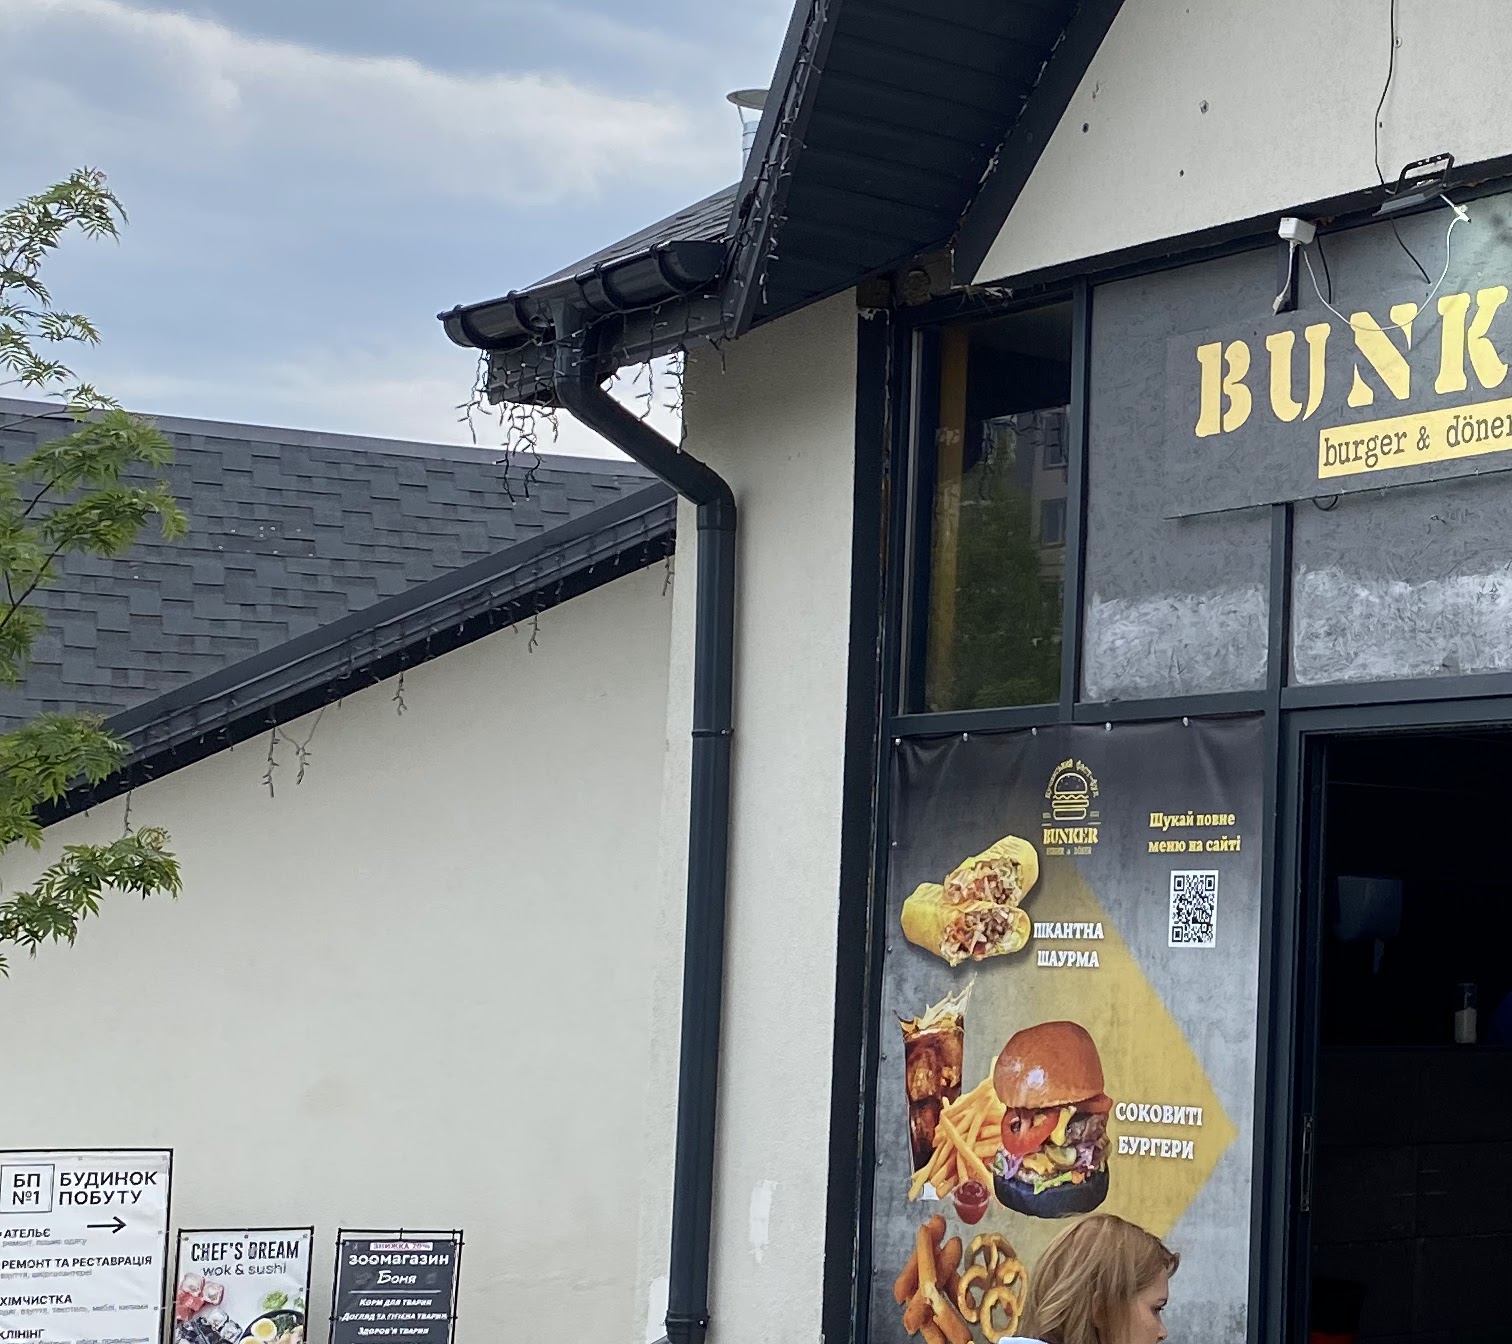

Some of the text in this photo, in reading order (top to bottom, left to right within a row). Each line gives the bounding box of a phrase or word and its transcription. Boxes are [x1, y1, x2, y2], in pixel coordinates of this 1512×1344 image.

[1322, 427, 1407, 469] burger
[1416, 426, 1430, 451] &
[1196, 813, 1236, 827] повне
[1043, 827, 1099, 845] BUNKER
[1148, 835, 1241, 853] меню на сайті
[1033, 922, 1104, 939] ПІКАНТНА
[1037, 950, 1100, 968] ШАУРМА
[1115, 1102, 1203, 1126] СОКОВИТІ
[1118, 1135, 1194, 1160] БУРГЕРИ
[13, 1173, 41, 1188] БП
[60, 1171, 158, 1189] БУДИНОК
[12, 1190, 40, 1205] №1
[59, 1190, 142, 1205] ПОБУТУ
[3, 1227, 51, 1239] АТЕЛЬЄ
[191, 1241, 299, 1262] CHEF'S DREAM
[2, 1256, 152, 1270] РЕМОНТ ТА РЕСТАВРАЦІЯ
[202, 1262, 287, 1276] wok & sushi
[377, 1270, 417, 1285] Боня
[0, 1294, 73, 1306] ХІМЧИСТКА
